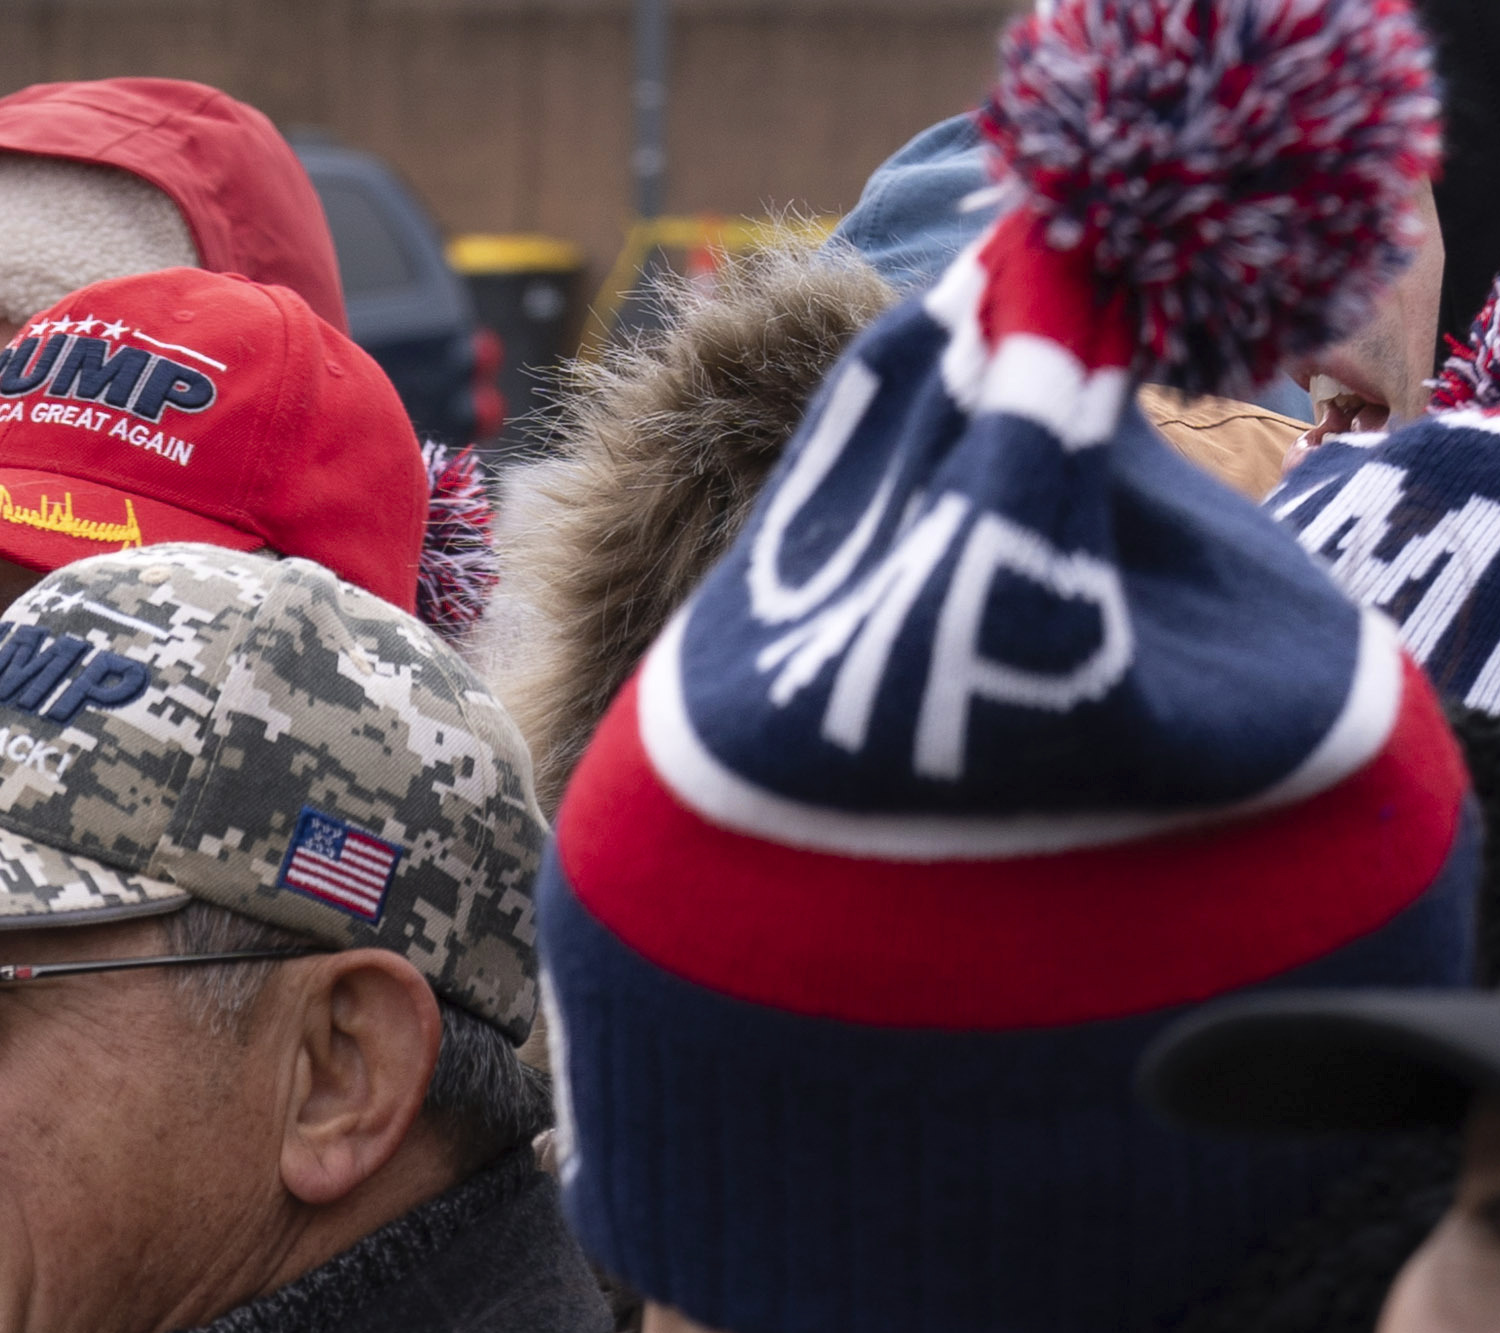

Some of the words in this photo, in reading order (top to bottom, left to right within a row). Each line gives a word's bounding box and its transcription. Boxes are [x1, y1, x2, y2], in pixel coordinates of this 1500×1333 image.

[30, 402, 111, 433] GREAT
[107, 419, 195, 467] AGAIN
[744, 356, 1136, 782] UMP
